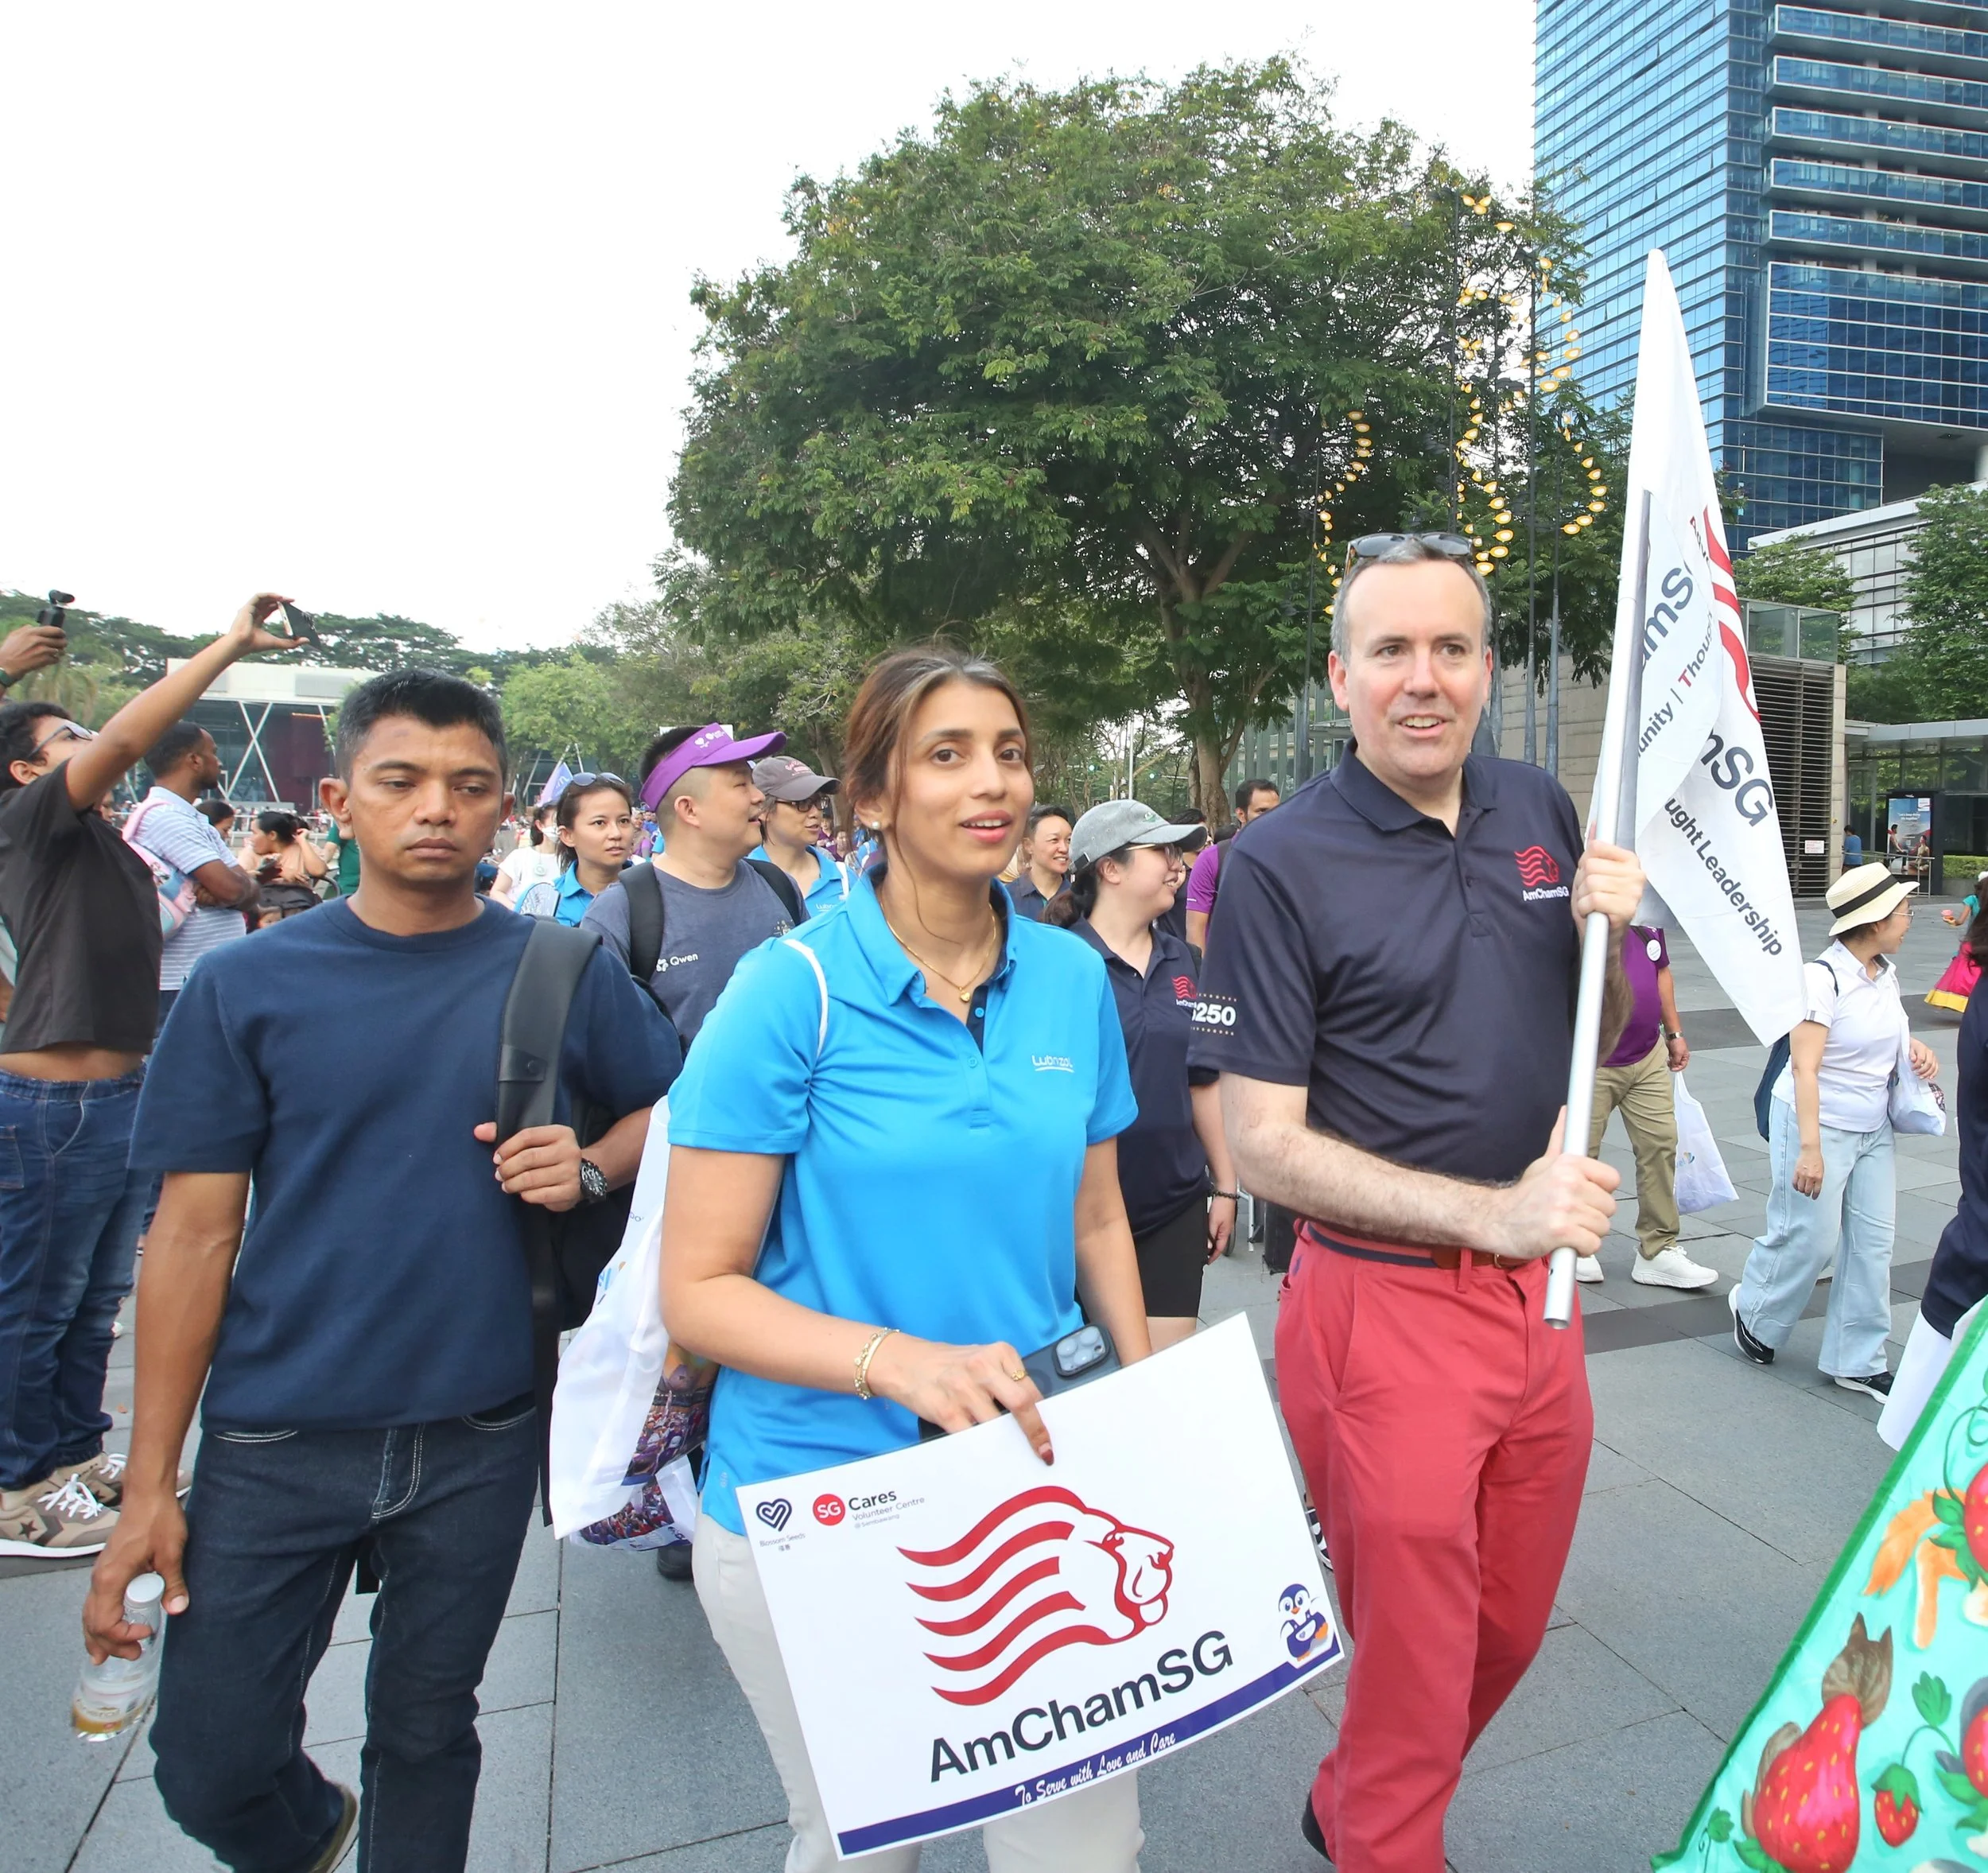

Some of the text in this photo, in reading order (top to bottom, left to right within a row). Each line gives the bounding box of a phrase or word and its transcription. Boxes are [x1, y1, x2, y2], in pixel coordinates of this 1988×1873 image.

[1638, 701, 1674, 758] unity
[1523, 885, 1570, 901] AmChamSG
[1696, 840, 1783, 956] Leadership
[670, 953, 698, 966] Qwen
[1192, 1001, 1237, 1027] 250
[817, 1490, 897, 1518] SG Cares
[852, 1496, 926, 1521] Volunteer Centre
[930, 1630, 1233, 1783] AmChamSG
[1015, 1732, 1176, 1805] To Serve with Love and Care
